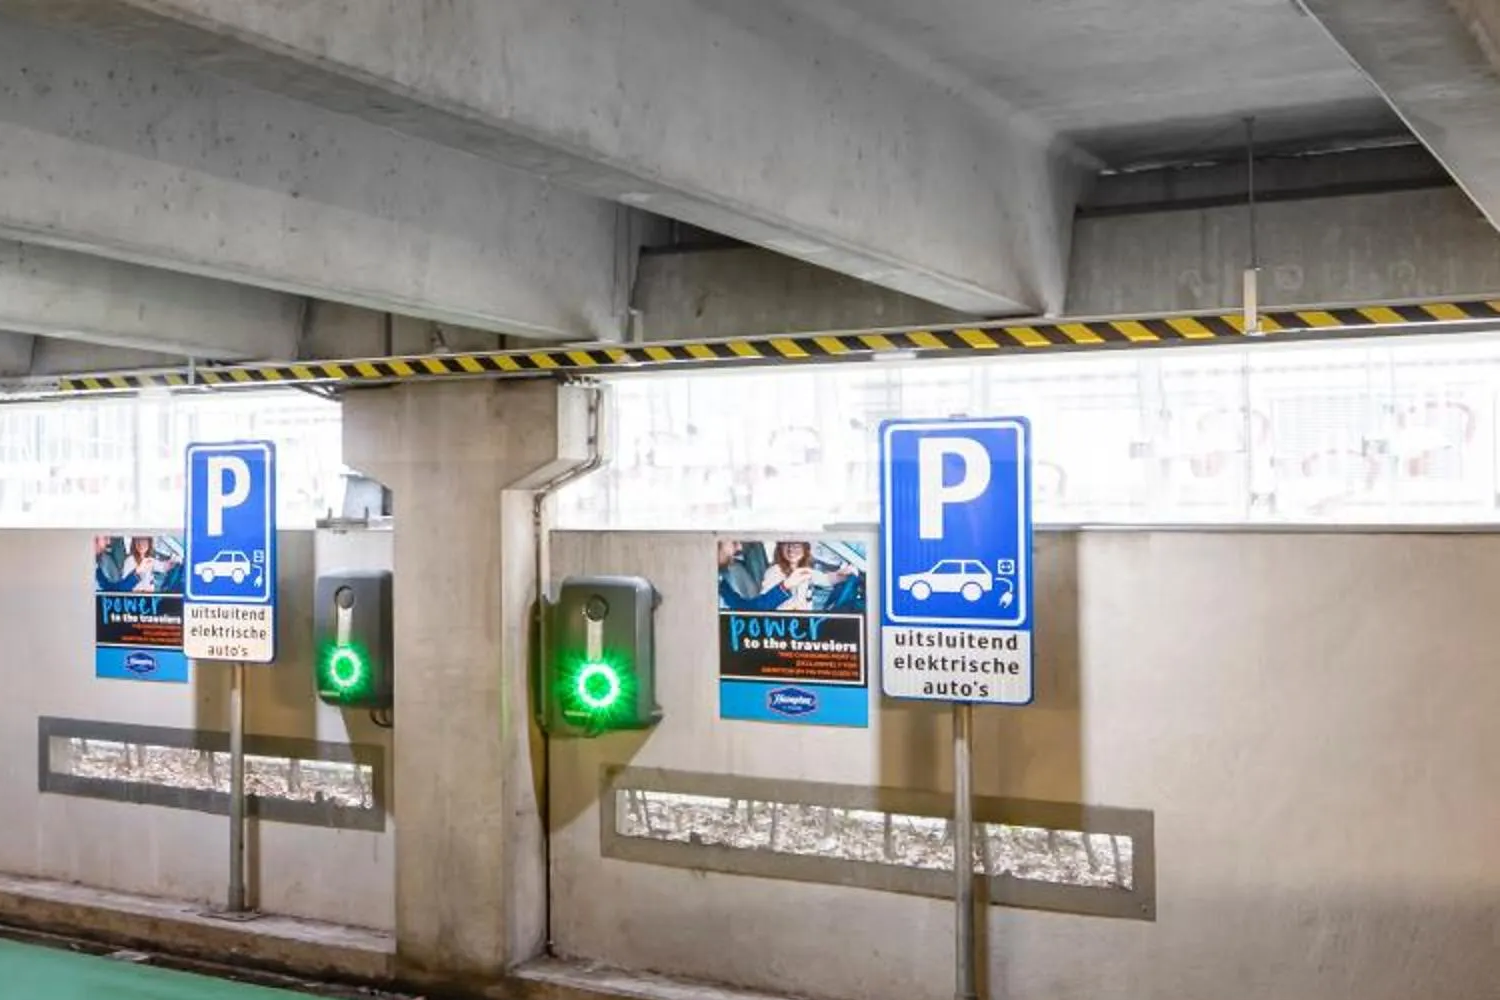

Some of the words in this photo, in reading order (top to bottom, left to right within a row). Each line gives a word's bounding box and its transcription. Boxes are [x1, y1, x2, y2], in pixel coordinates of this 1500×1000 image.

[207, 456, 251, 537] P
[918, 437, 992, 539] P
[102, 596, 162, 625] power
[191, 608, 266, 621] uitsluitend
[190, 625, 267, 641] elektrische
[730, 616, 832, 652] power
[894, 630, 1018, 651] uitsluitend
[207, 643, 249, 658] auto's
[743, 638, 760, 649] to
[763, 638, 787, 650] the
[791, 639, 858, 653] travelers
[893, 654, 1020, 675] elektrische
[923, 680, 990, 697] auto's
